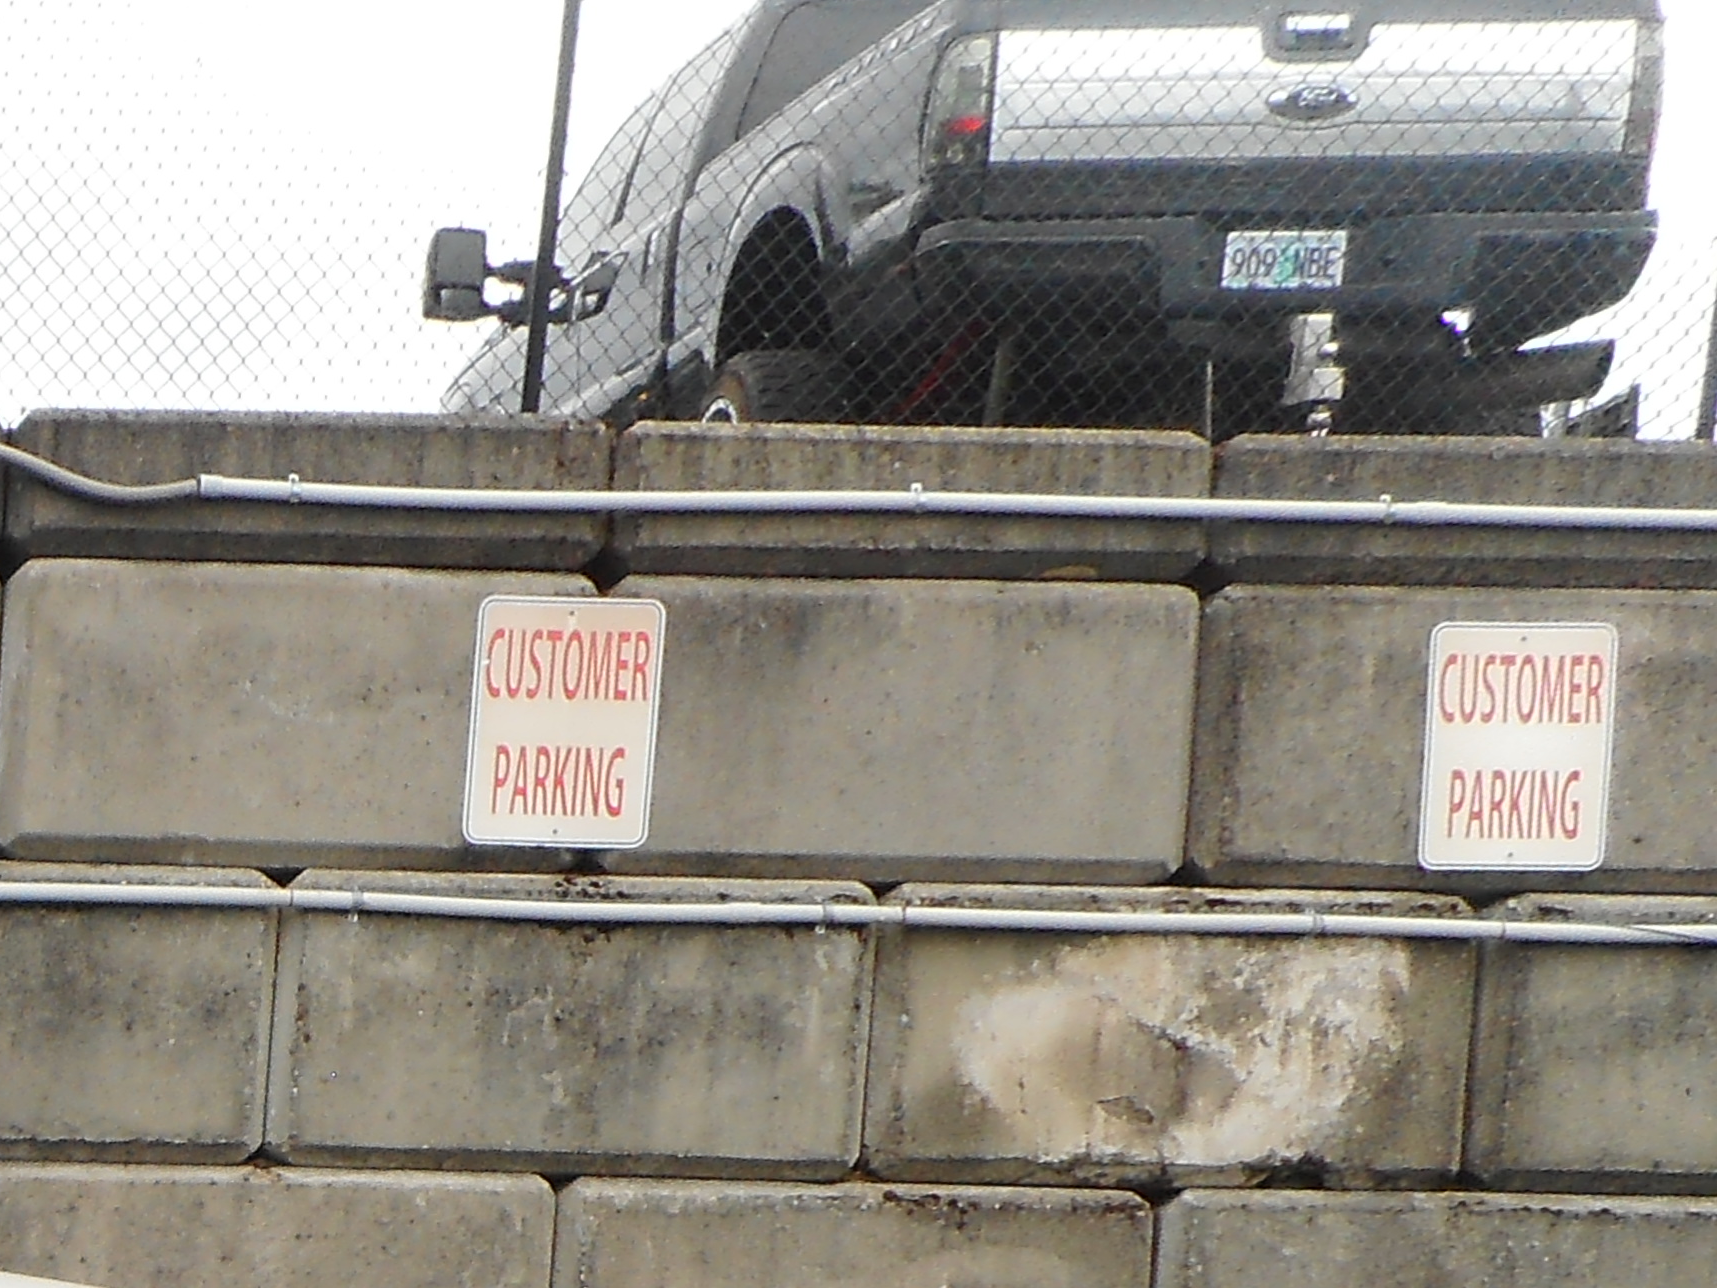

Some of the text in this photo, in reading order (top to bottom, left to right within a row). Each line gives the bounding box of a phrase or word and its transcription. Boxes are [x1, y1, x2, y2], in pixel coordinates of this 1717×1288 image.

[1232, 247, 1278, 278] 909
[485, 628, 652, 701] CUSTOMER
[1439, 653, 1605, 724] CUSTOMER
[491, 745, 626, 817] PARKING
[1447, 769, 1581, 839] PARKING
